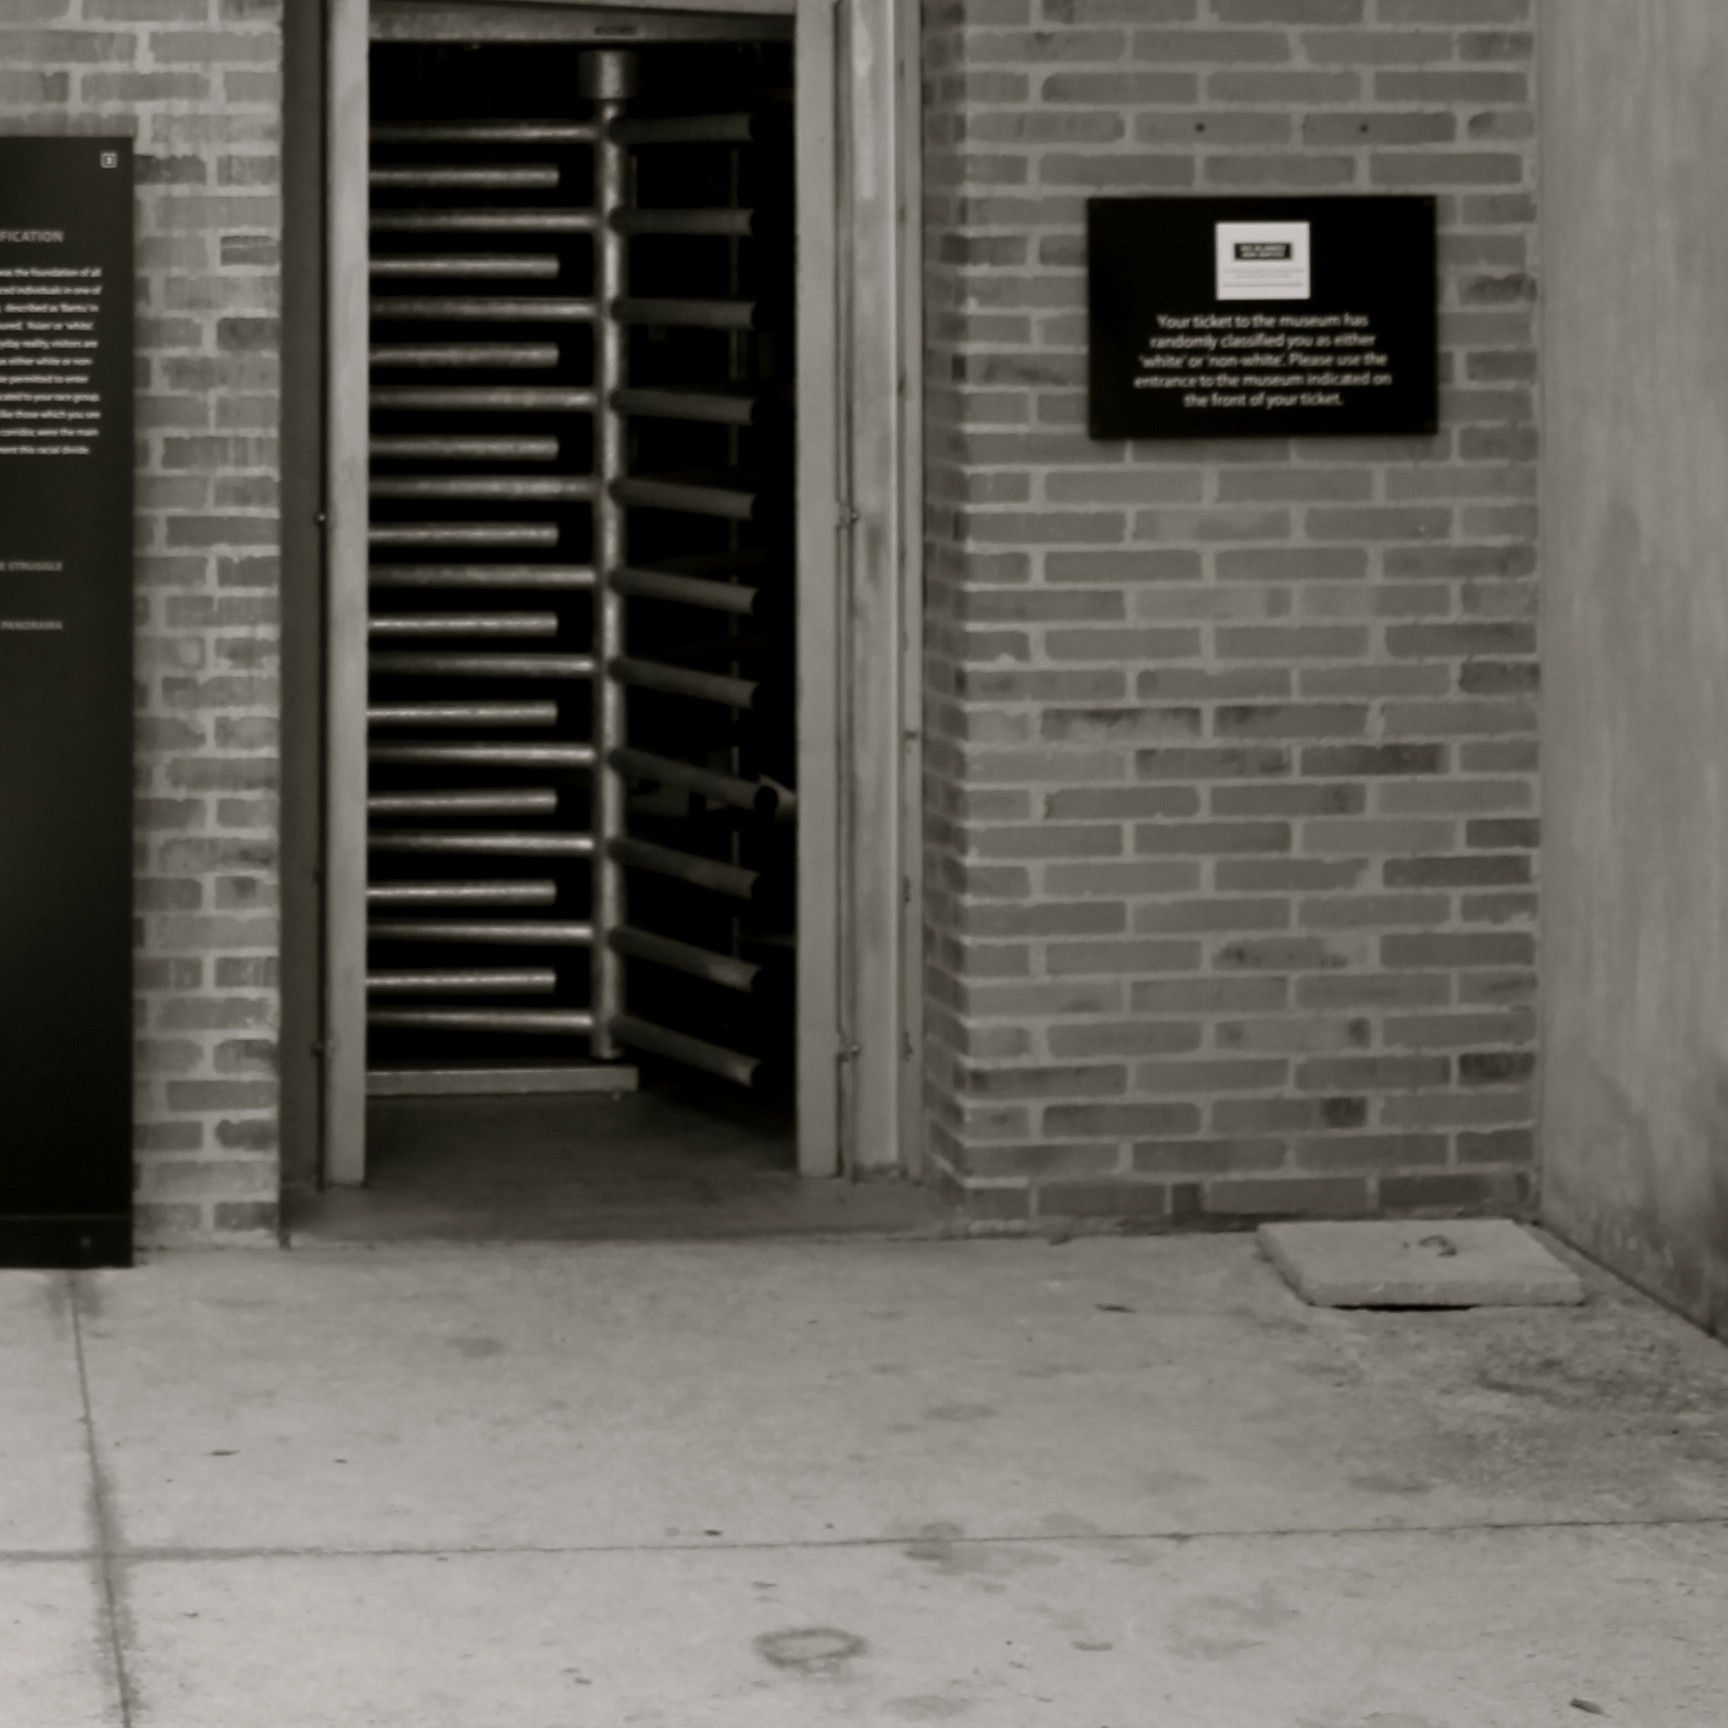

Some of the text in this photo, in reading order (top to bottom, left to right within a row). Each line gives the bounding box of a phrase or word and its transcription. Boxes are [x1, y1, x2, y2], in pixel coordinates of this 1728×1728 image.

[1156, 313, 1369, 329] Your ticket to the museum has
[1149, 333, 1376, 351] randomly classified you as either
[1188, 357, 1204, 368] or
[1288, 353, 1334, 366] Please
[1336, 355, 1361, 366] use
[1363, 352, 1388, 365] the
[1133, 372, 1392, 388] entrance to the museum indicated on
[1183, 392, 1208, 407] the
[1210, 392, 1247, 407] front
[1248, 392, 1264, 407] of
[1266, 394, 1300, 409] your
